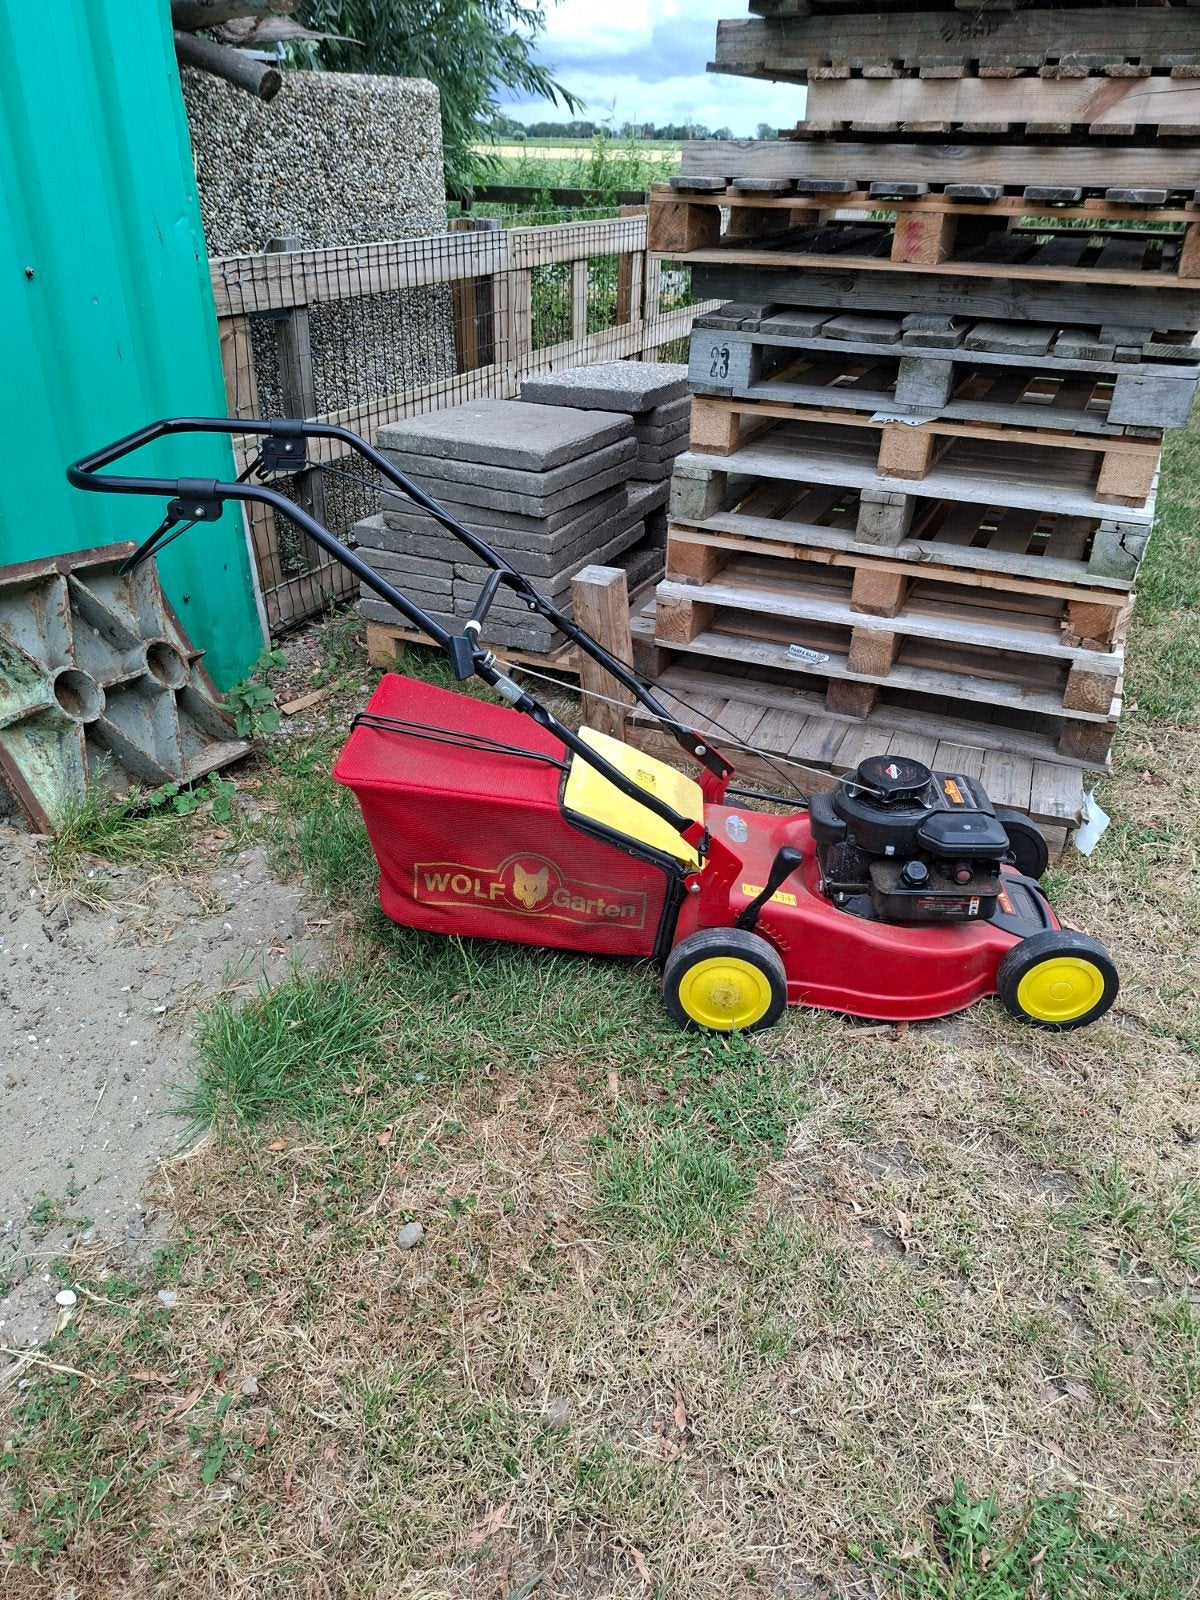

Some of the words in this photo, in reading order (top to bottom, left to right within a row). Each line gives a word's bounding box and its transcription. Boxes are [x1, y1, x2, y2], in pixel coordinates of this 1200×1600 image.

[710, 346, 730, 379] 23
[424, 873, 506, 900] WOLF
[552, 887, 636, 918] Garten
